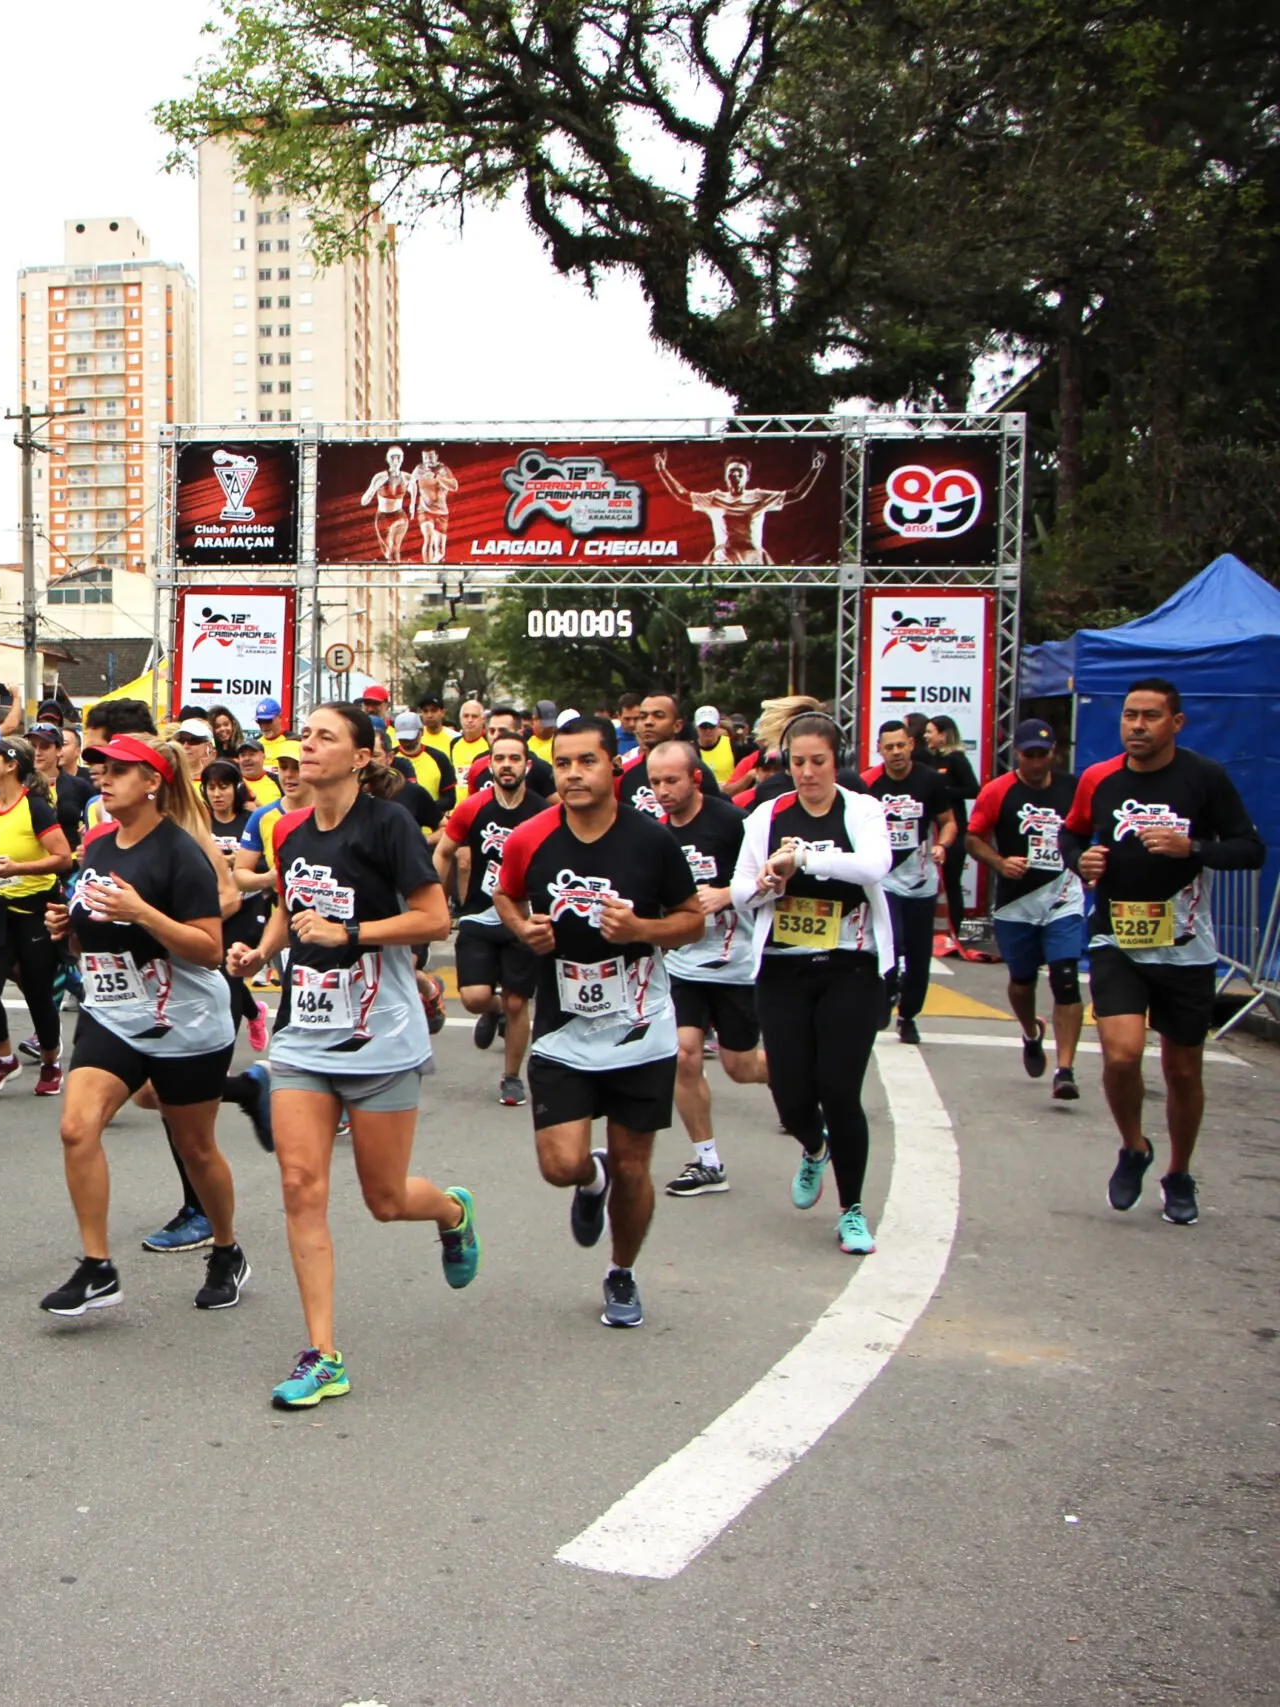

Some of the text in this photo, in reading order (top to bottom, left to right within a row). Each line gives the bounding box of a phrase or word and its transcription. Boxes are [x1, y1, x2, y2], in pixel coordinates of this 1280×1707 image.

[524, 481, 608, 491] CORRIDA 10K
[535, 490, 632, 500] CAMINHADA 5K
[194, 524, 274, 534] Clube Atlético
[904, 524, 935, 533] anos
[194, 537, 275, 550] ARAMAÇAN
[470, 539, 562, 556] LARGADA
[584, 540, 678, 556] CHEGADA
[334, 650, 344, 665] E
[226, 679, 271, 695] ISDIN
[920, 686, 971, 703] ISDIN
[891, 832, 909, 841] 516
[1033, 849, 1060, 861] 340
[779, 914, 827, 936] 5382
[1115, 920, 1160, 936] 5287
[94, 972, 129, 993] 235
[578, 983, 604, 1003] 68
[297, 990, 334, 1012] 484
[574, 1002, 611, 1012] LEANDRO
